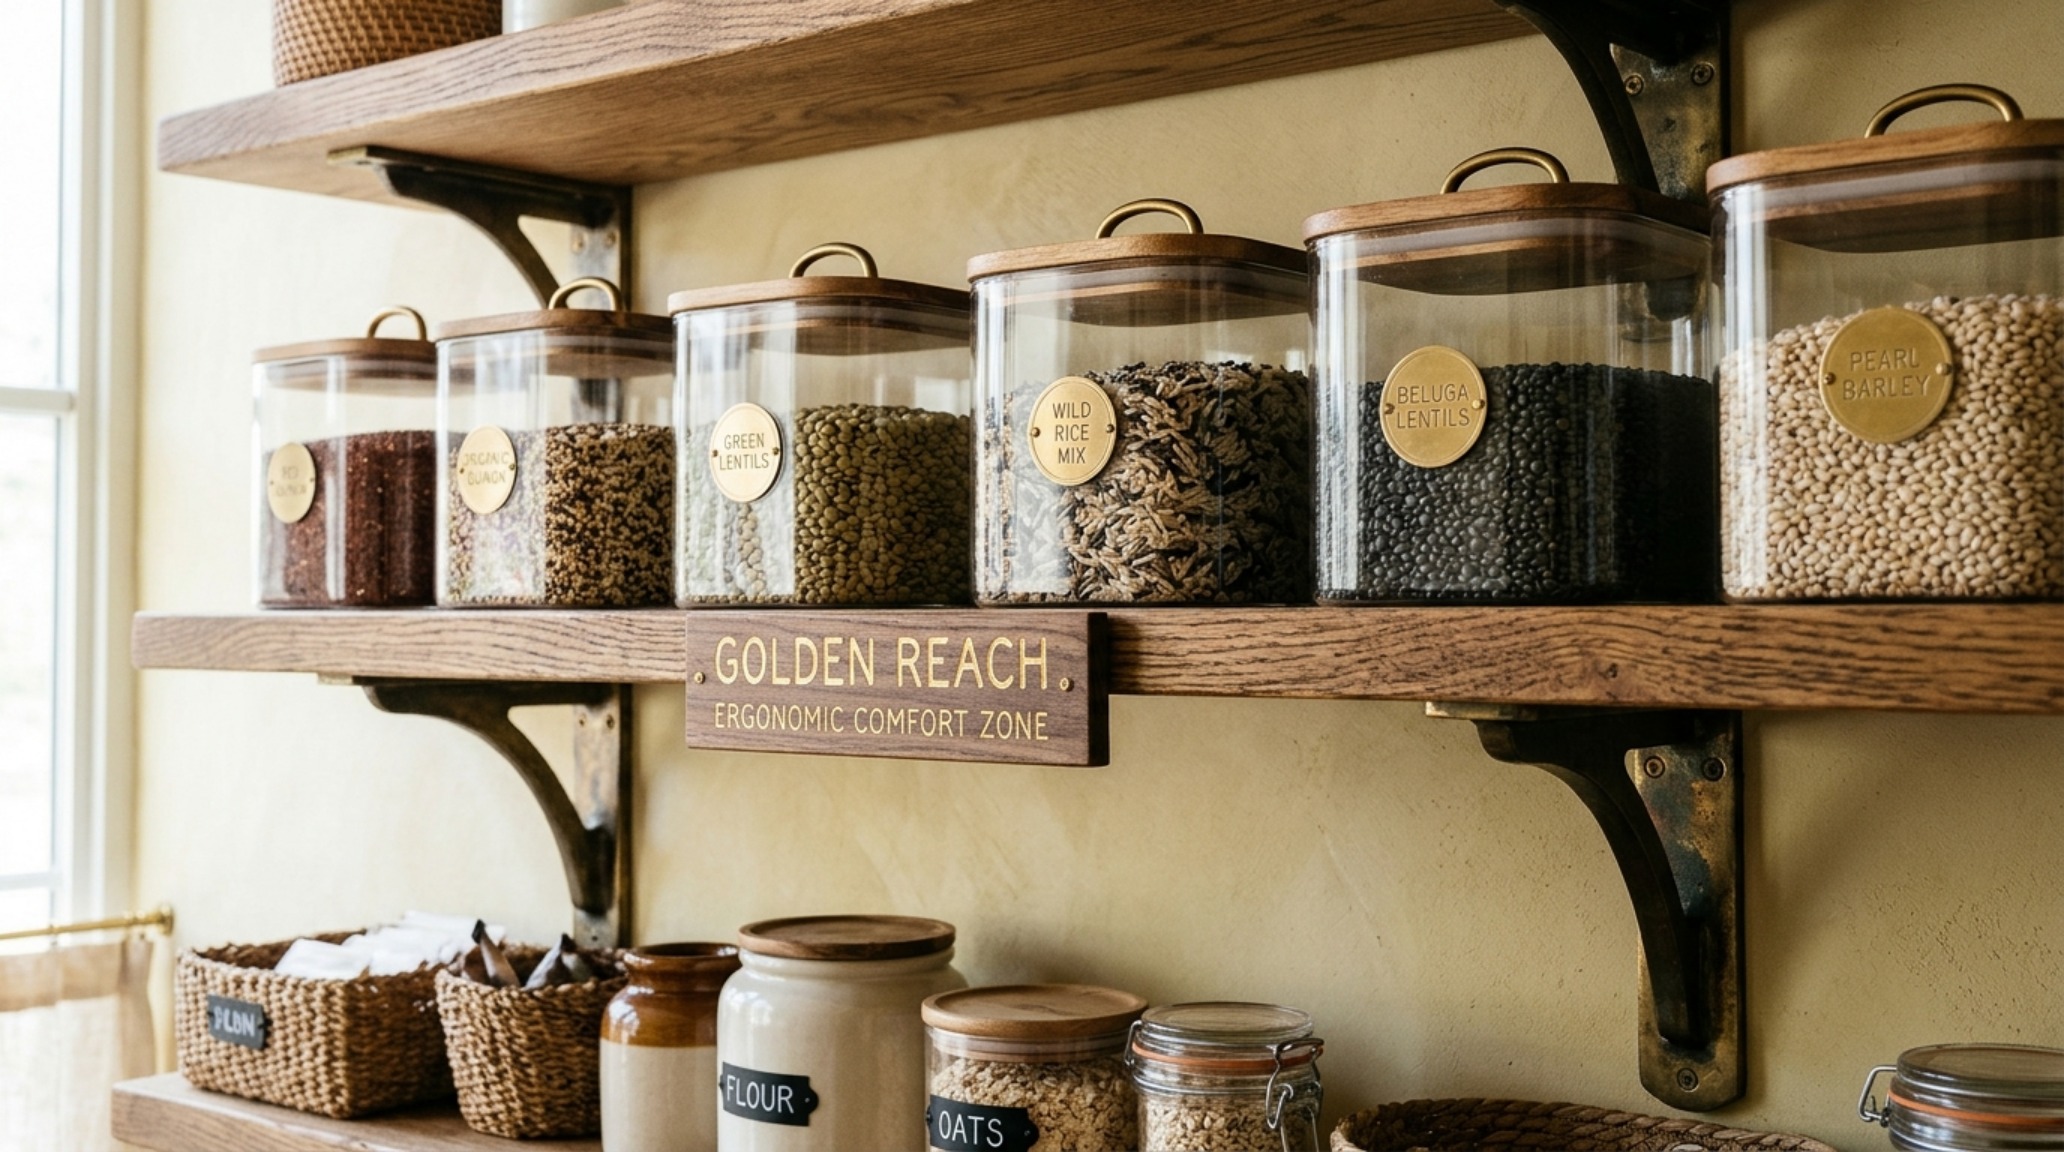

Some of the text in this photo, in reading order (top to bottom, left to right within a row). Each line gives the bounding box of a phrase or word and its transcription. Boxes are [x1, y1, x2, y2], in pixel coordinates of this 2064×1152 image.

[1849, 347, 1919, 371] PEARL
[1397, 384, 1469, 405] BELUGA
[1842, 375, 1931, 401] BARLEY
[1052, 401, 1091, 419] WILD
[1396, 408, 1470, 429] LENTILS
[724, 433, 765, 450] GREEN
[1054, 424, 1090, 441] RICE
[719, 452, 770, 471] LENTILS
[1058, 446, 1086, 464] MIX
[715, 636, 1048, 689] GOLDEN REACH
[714, 702, 1049, 740] ERGONOMIC COMFORT ZONE
[727, 1074, 794, 1114] FLOUR
[938, 1110, 1004, 1148] OATS
